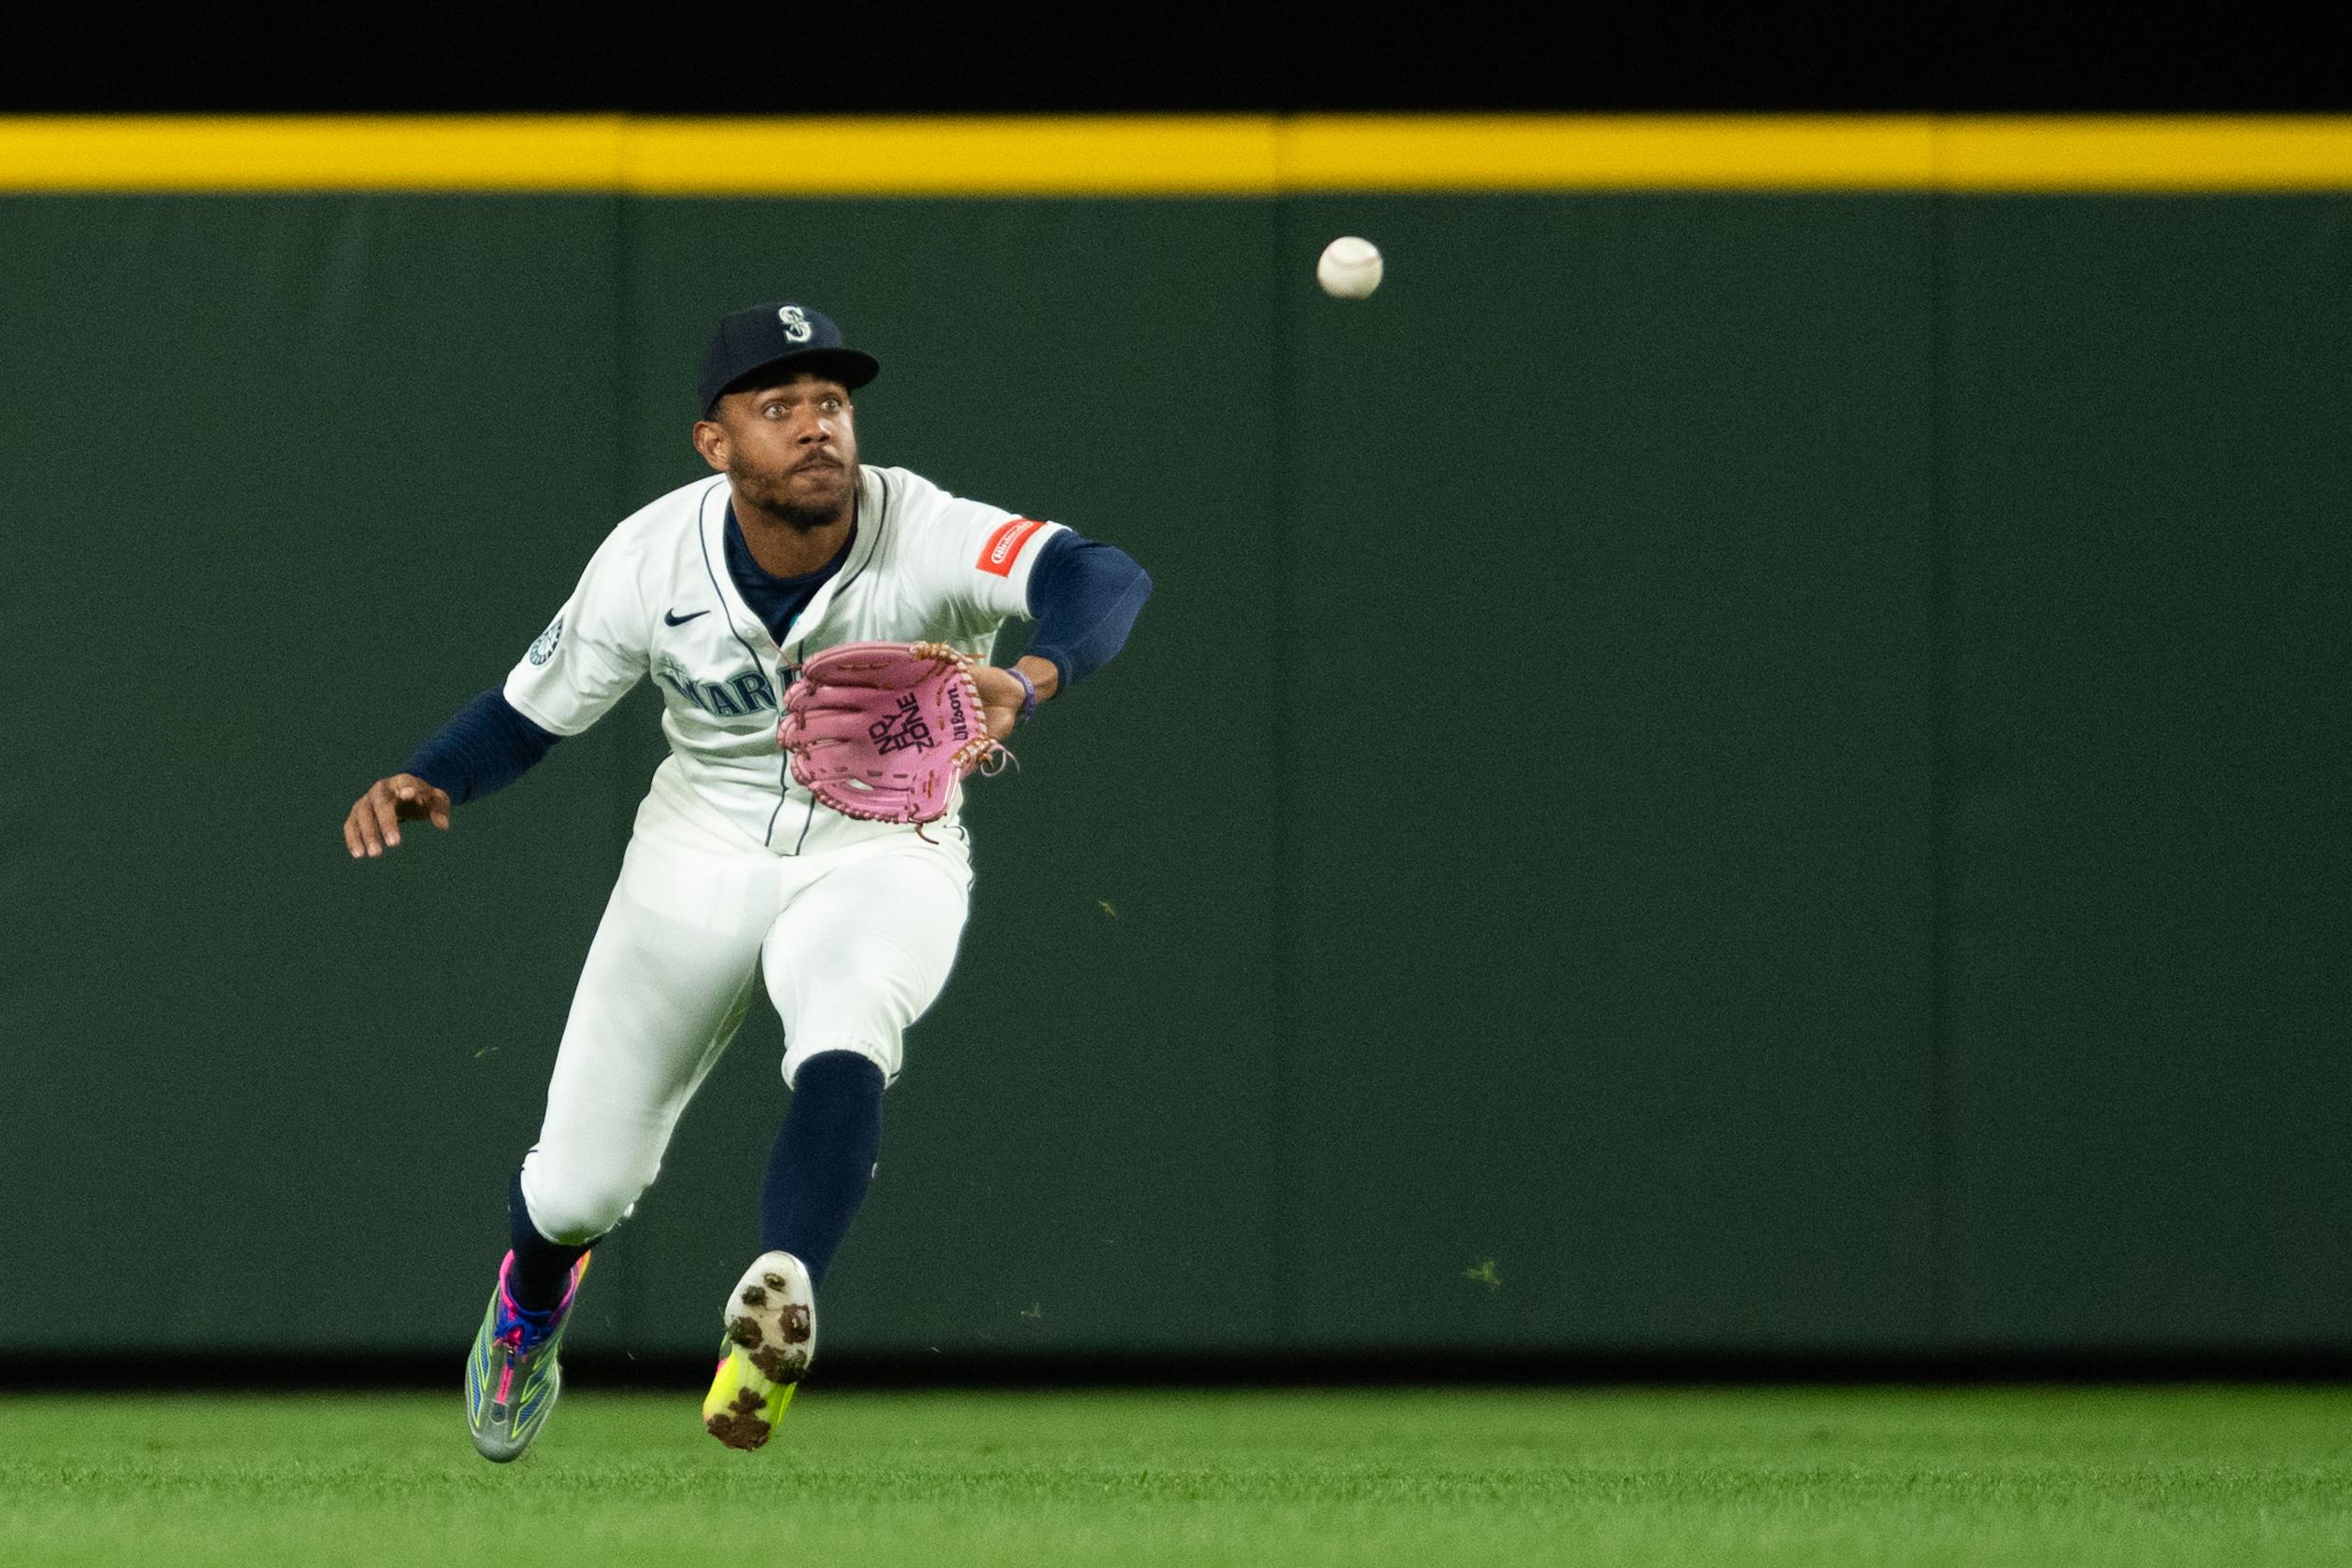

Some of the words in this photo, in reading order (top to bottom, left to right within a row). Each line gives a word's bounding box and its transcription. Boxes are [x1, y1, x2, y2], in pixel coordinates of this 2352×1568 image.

[779, 305, 812, 344] S
[882, 713, 916, 751] FLY
[896, 692, 934, 753] ZONE
[947, 684, 969, 741] Wilson
[869, 720, 897, 756] NO
